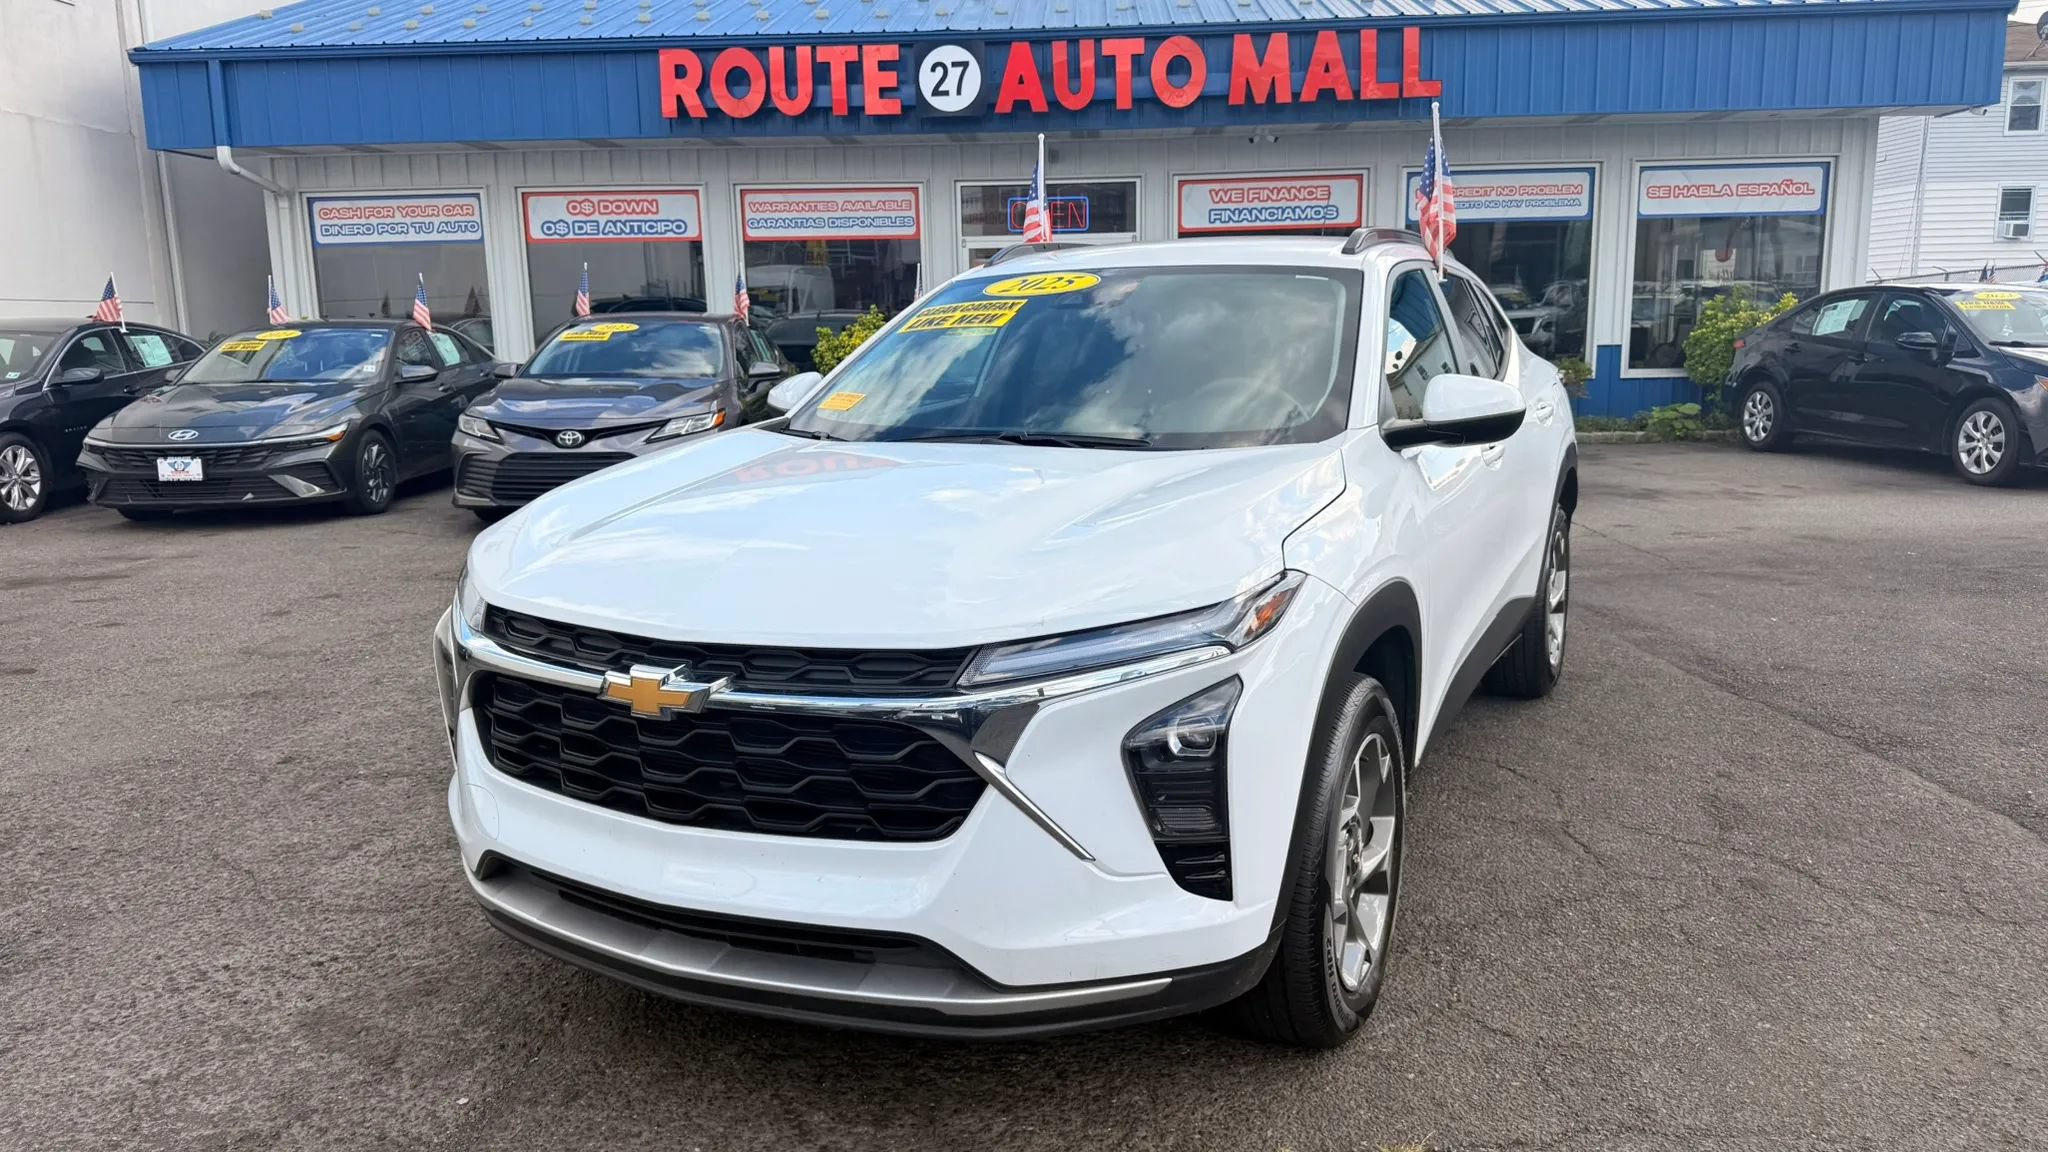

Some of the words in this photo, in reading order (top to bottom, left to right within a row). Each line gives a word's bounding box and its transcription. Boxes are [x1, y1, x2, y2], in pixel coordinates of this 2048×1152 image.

[658, 44, 902, 118] ROUTE
[930, 61, 969, 97] 27
[994, 35, 1207, 113] AUTO
[1228, 27, 1442, 106] MALL
[1209, 188, 1244, 203] WE
[1248, 185, 1331, 203] FINANCE
[1496, 185, 1517, 197] NO
[1519, 184, 1583, 197] PROBLEM
[1646, 185, 1671, 199] SE
[1673, 184, 1733, 198] HABLA
[1736, 179, 1815, 197] ESPAÑOL
[319, 207, 362, 220] CASH
[364, 206, 395, 219] FOR
[398, 205, 440, 218] YOUR
[442, 204, 474, 217] CAR
[598, 199, 659, 215] DOWN
[750, 201, 838, 213] WARRANTIES
[841, 200, 912, 212] AVAILABLE
[1454, 200, 1483, 210] EDITO
[1484, 199, 1500, 209] NO
[1501, 199, 1524, 208] HAY
[1525, 198, 1582, 208] PROBLEMA
[748, 217, 825, 229] GARANTIAS
[828, 216, 915, 228] DISPONIBLES
[1011, 201, 1085, 228] OEN
[1209, 205, 1339, 223] FINANCIAMOS
[321, 223, 375, 237] DINERO
[377, 223, 409, 236] POR
[411, 222, 434, 235] TU
[436, 220, 480, 234] AUTO
[572, 220, 599, 235] DE
[602, 218, 687, 235] ANTICIPO
[999, 275, 1085, 293] 2025
[917, 304, 961, 317] CLEAN
[959, 301, 1022, 313] CARFAX
[909, 314, 950, 329] LIKE
[950, 312, 1006, 326] NEW
